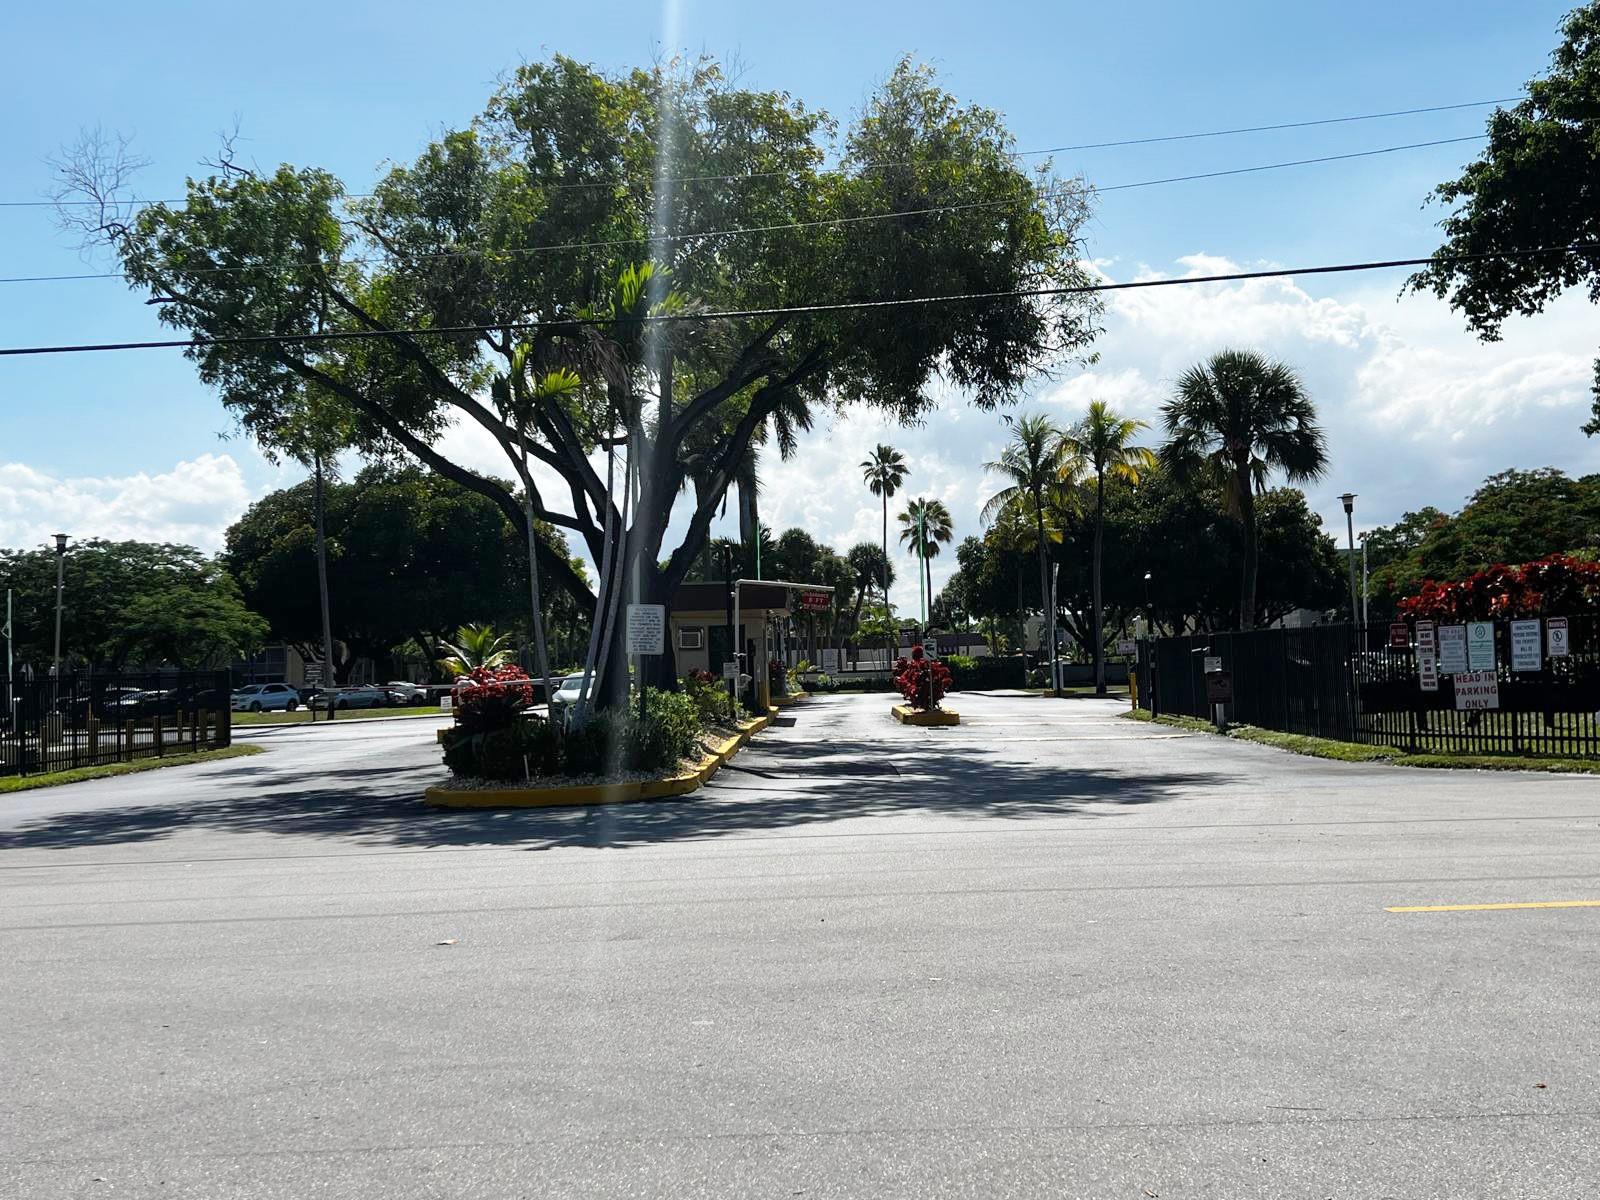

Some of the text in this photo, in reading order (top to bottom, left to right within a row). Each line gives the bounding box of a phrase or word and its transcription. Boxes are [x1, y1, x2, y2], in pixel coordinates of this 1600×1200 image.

[1456, 672, 1494, 683] HEAD IN
[1456, 685, 1497, 696] PARKING
[1465, 699, 1489, 708] ONLY
